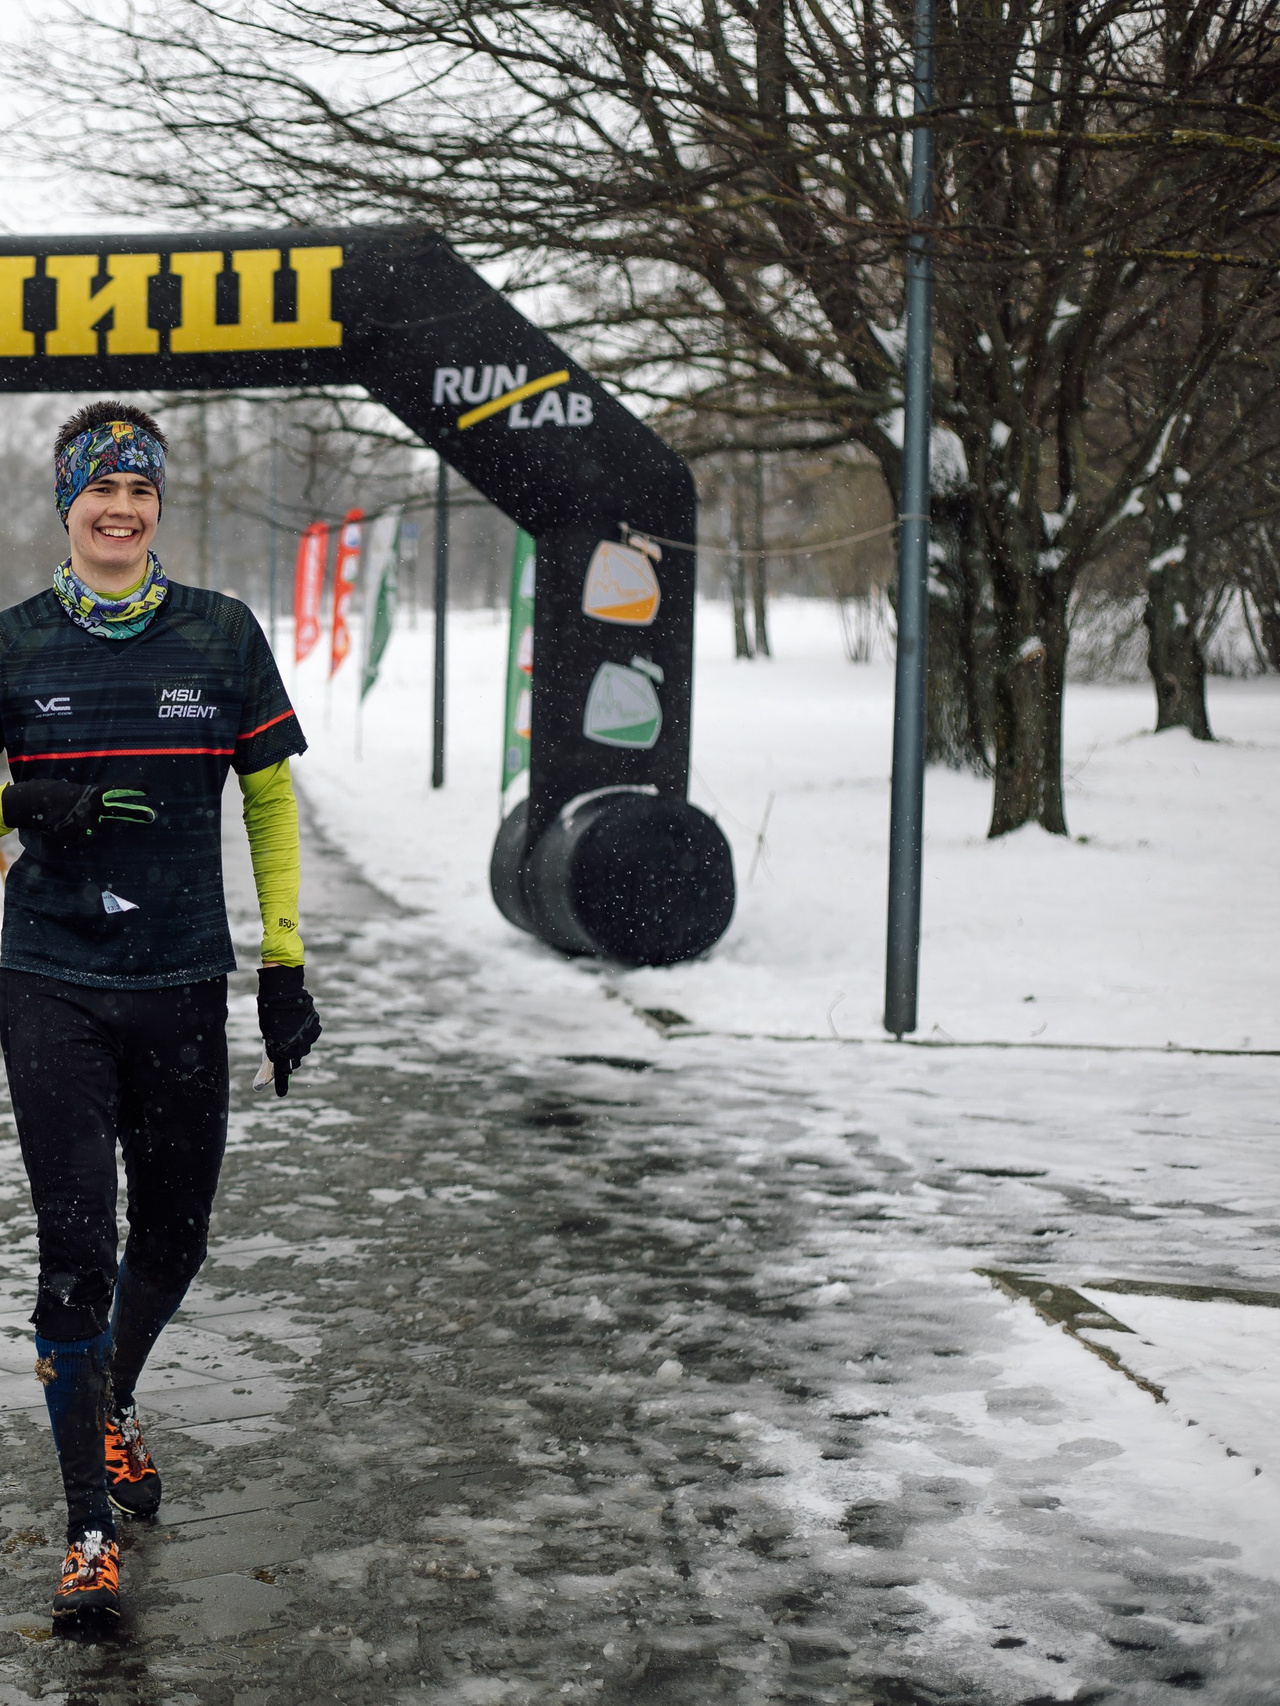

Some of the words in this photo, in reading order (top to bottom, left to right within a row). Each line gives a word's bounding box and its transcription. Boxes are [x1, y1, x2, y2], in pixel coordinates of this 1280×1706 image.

[432, 364, 528, 405] RUN
[507, 390, 594, 429] LAB
[161, 689, 202, 702] MSU
[34, 697, 71, 712] VC
[158, 704, 217, 719] ORIENT
